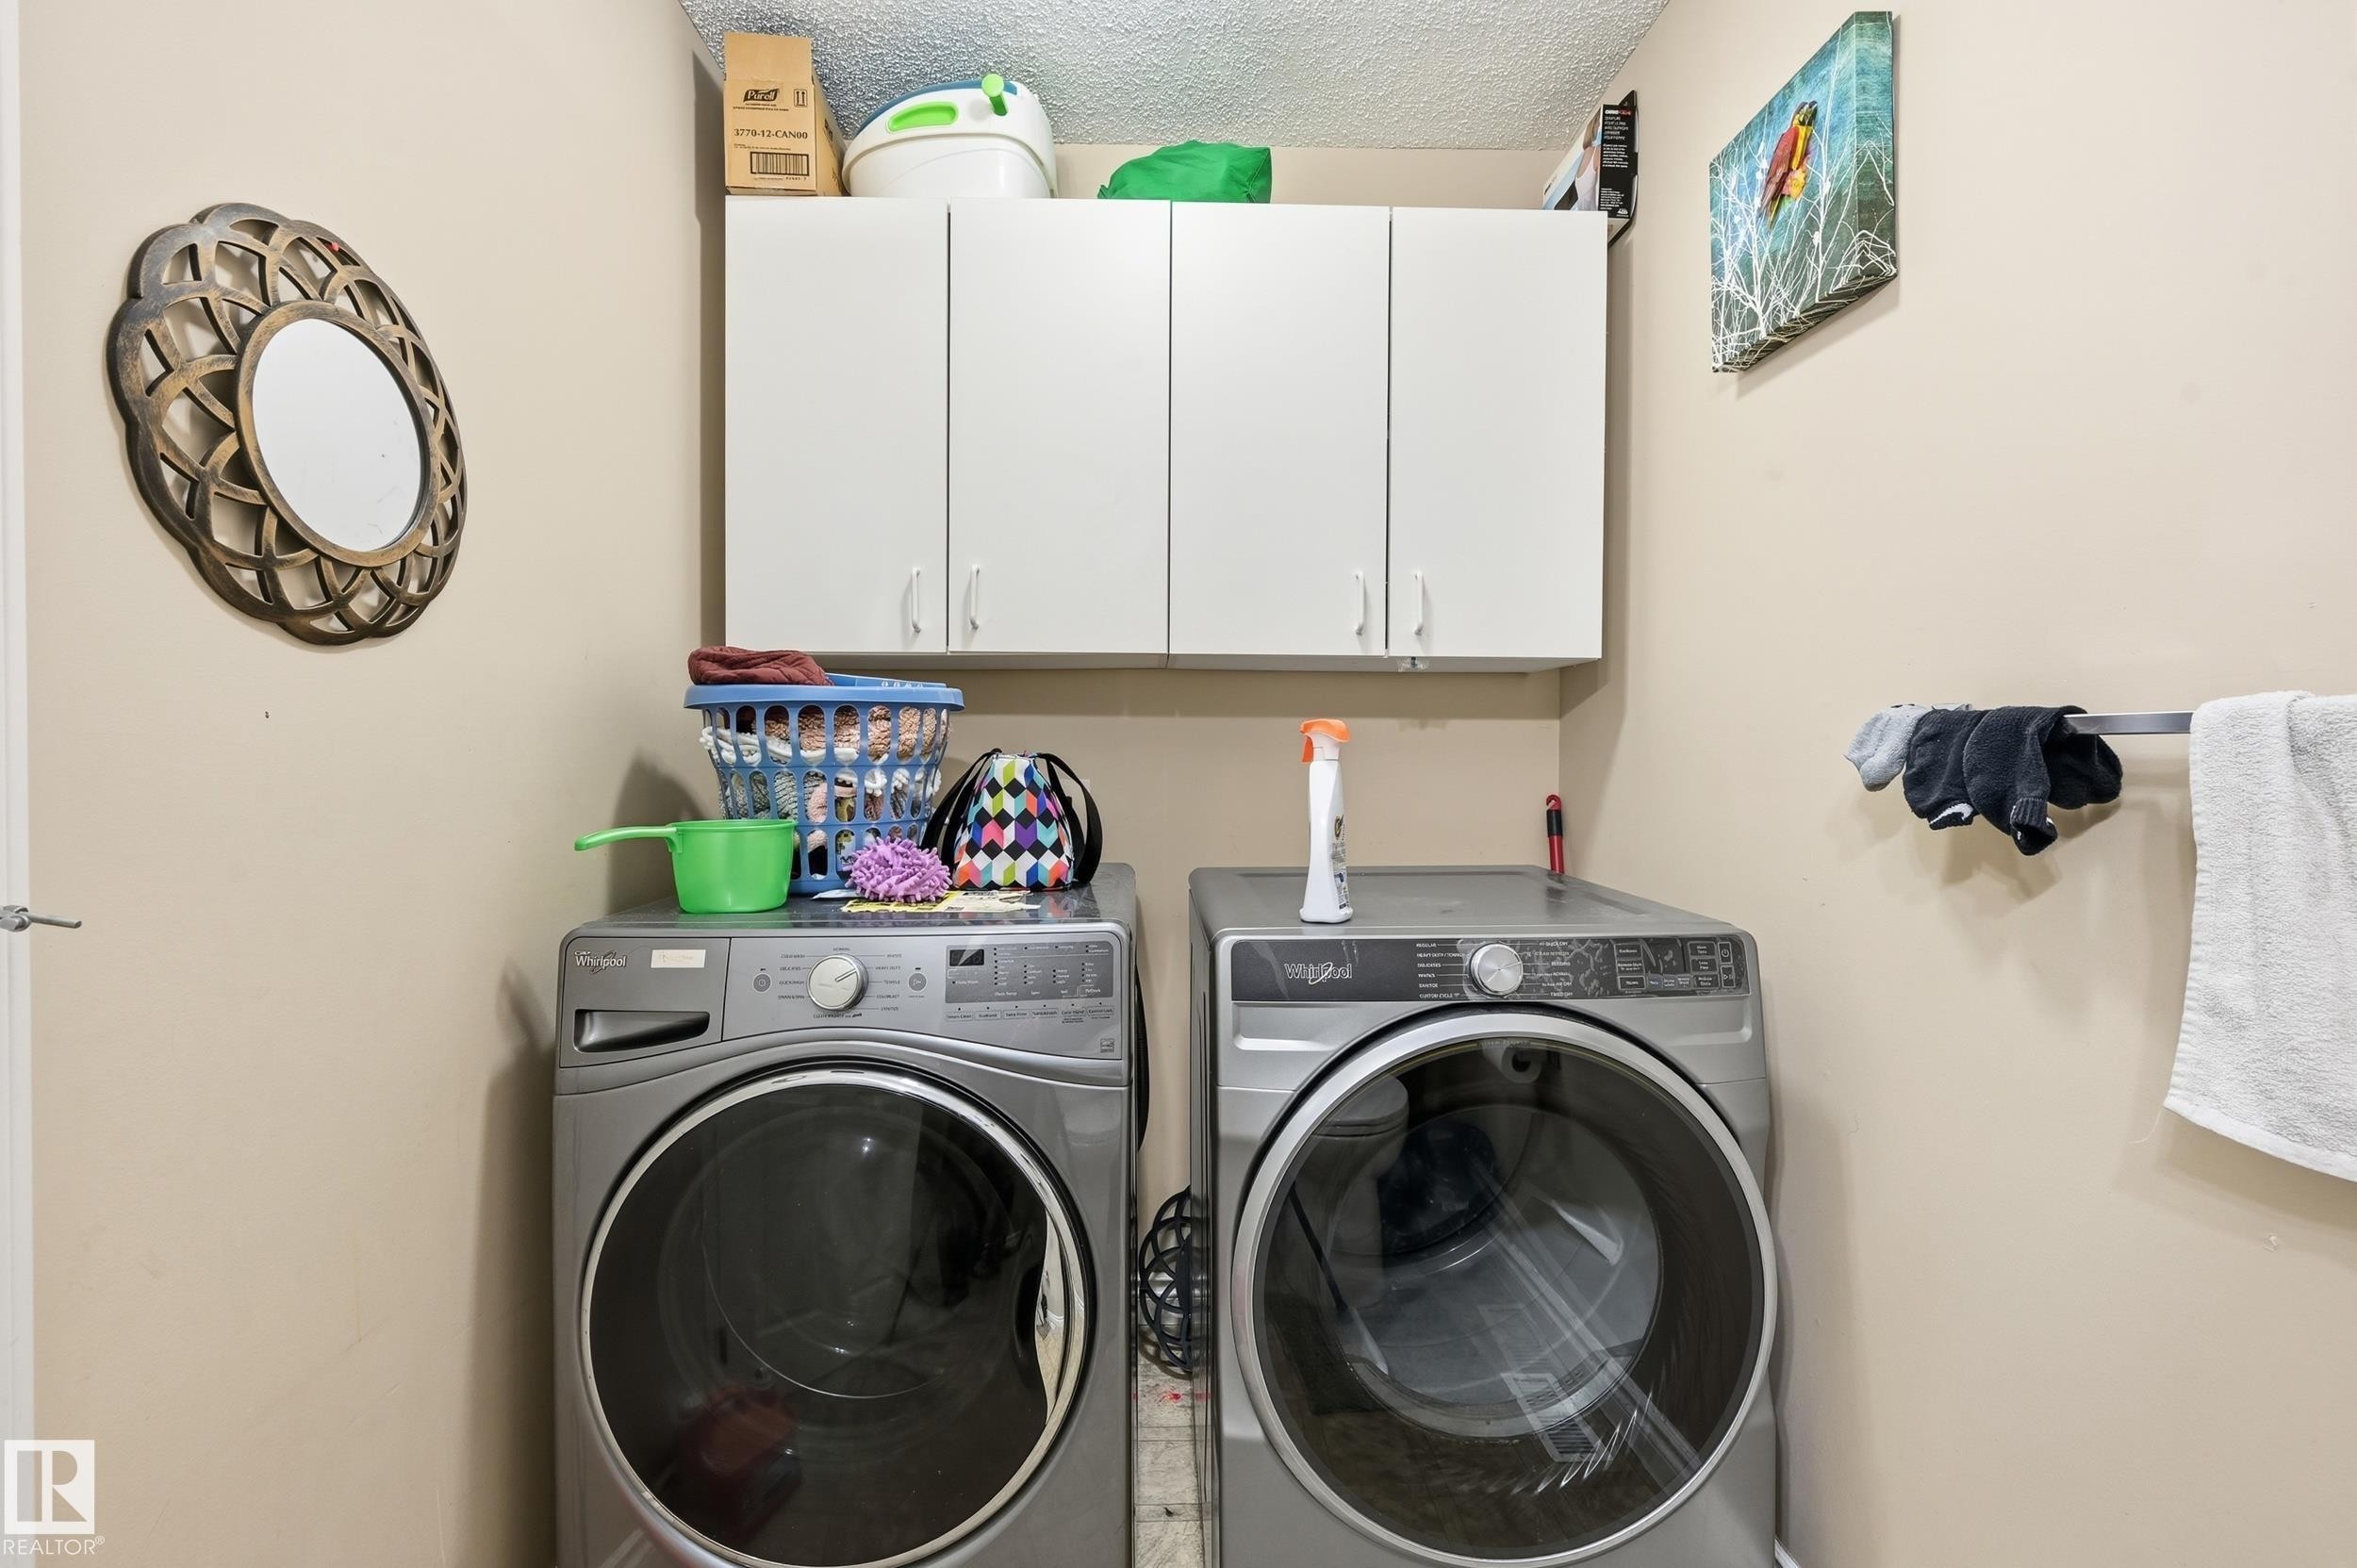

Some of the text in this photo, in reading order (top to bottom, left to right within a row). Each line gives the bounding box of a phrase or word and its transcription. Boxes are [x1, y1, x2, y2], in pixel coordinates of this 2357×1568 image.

[733, 128, 808, 140] 3770-12-CAN00
[575, 952, 627, 970] Whirlpool
[1284, 962, 1353, 982] Whirlpool
